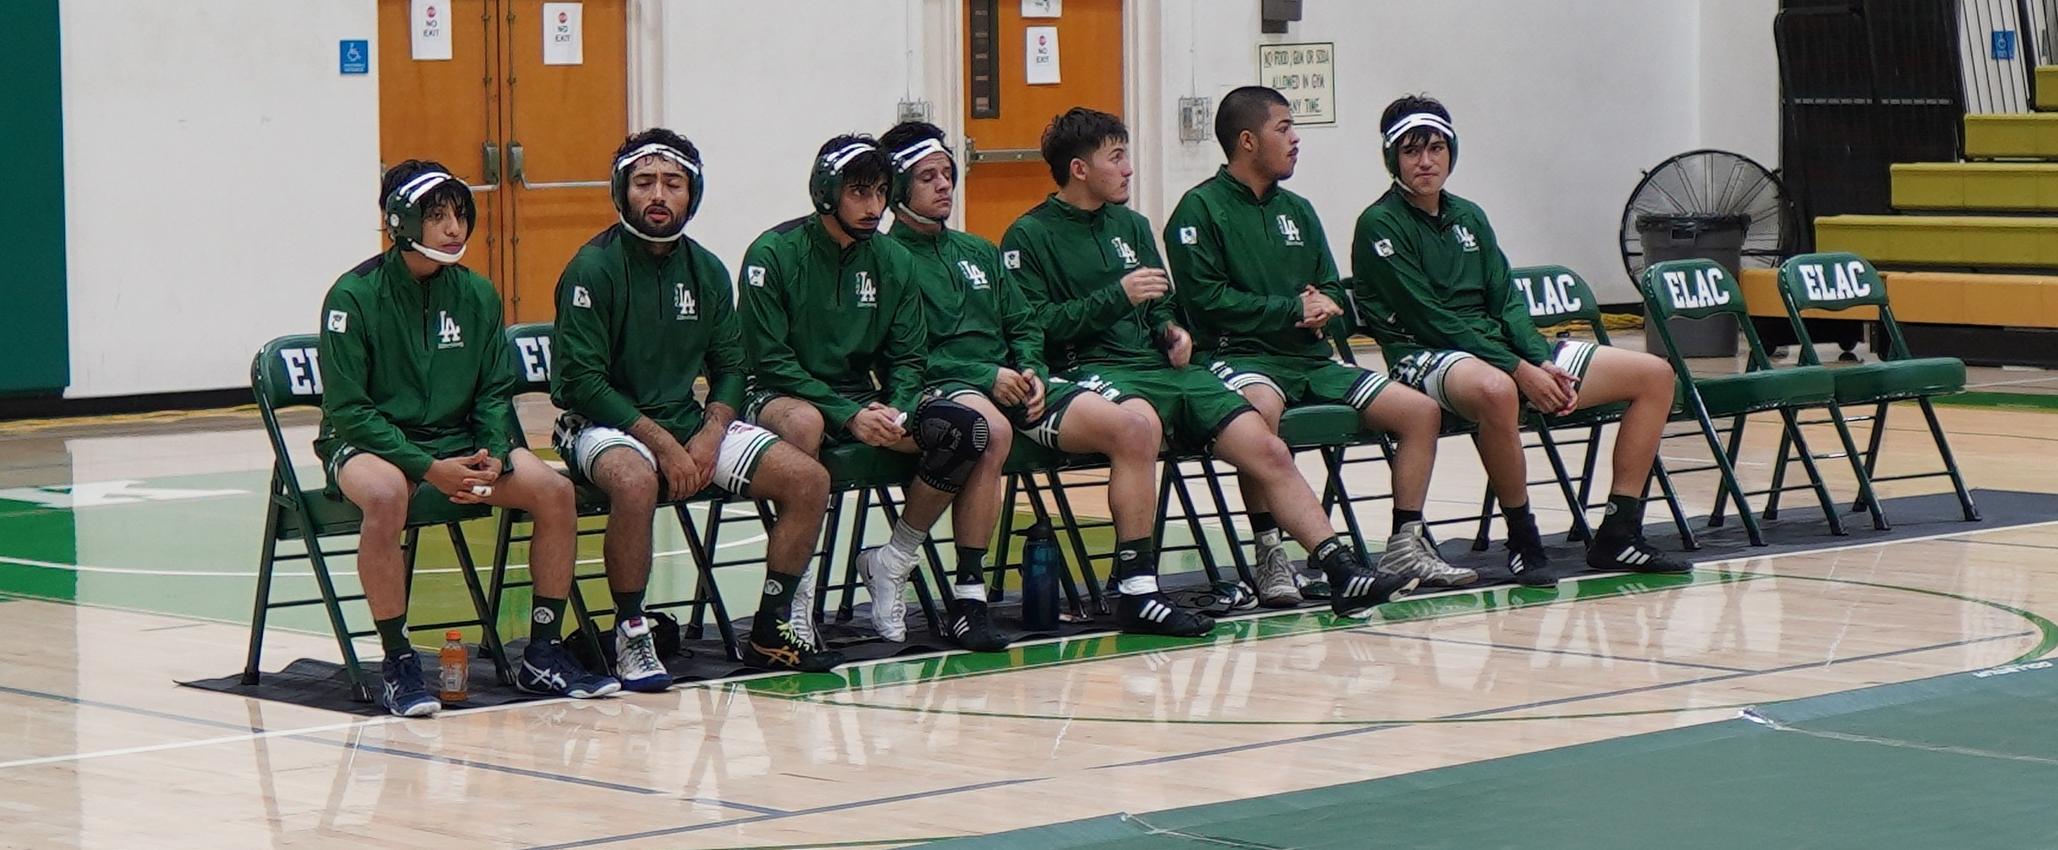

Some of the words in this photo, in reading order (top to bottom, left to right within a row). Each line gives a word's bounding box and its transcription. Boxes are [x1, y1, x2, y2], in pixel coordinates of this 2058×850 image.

[426, 20, 438, 28] NO
[557, 25, 569, 33] NO
[423, 29, 440, 38] EXIT
[555, 34, 571, 43] EXIT
[1038, 47, 1048, 55] NO
[1036, 56, 1050, 64] EXIT
[1302, 73, 1309, 89] IN
[1279, 214, 1301, 241] LA
[860, 271, 877, 302] LA
[1799, 259, 1872, 301] ELAC
[1662, 267, 1731, 310] ELAC
[677, 282, 696, 315] LA
[438, 310, 461, 343] LA
